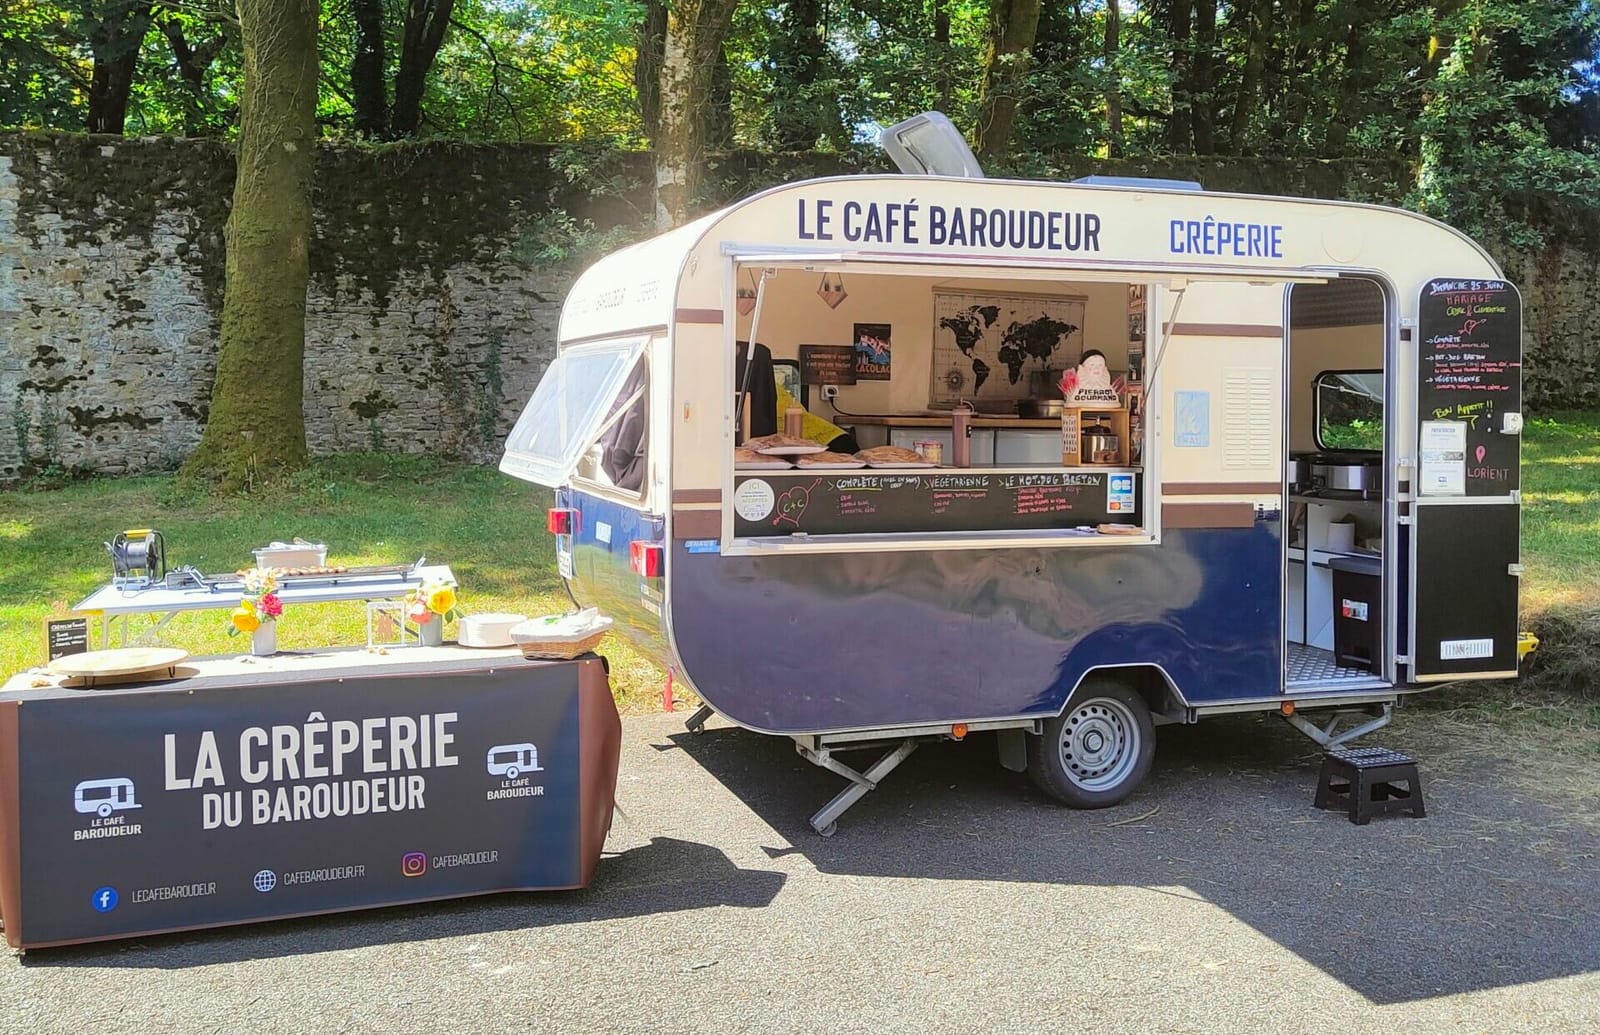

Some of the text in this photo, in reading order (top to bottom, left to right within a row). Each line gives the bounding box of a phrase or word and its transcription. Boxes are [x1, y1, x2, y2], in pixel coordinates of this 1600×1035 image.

[799, 198, 1101, 252] LE CAFÉ BAROUDEUR
[1169, 215, 1283, 258] CRÊPERIE
[1004, 475, 1015, 488] LE
[1062, 473, 1102, 486] BRETON
[163, 711, 459, 790] LA CRÊPERIE
[501, 777, 530, 788] LE CAFÉ
[202, 775, 426, 830] DU BAROUDEUR
[486, 786, 545, 801] BAROUDEUR
[91, 815, 126, 827] LE CAFÉ
[73, 824, 142, 841] BAROUDEUR
[432, 850, 499, 870] CAFEBAROUDEUR
[131, 881, 218, 904] LECAFEBAROUDEUR
